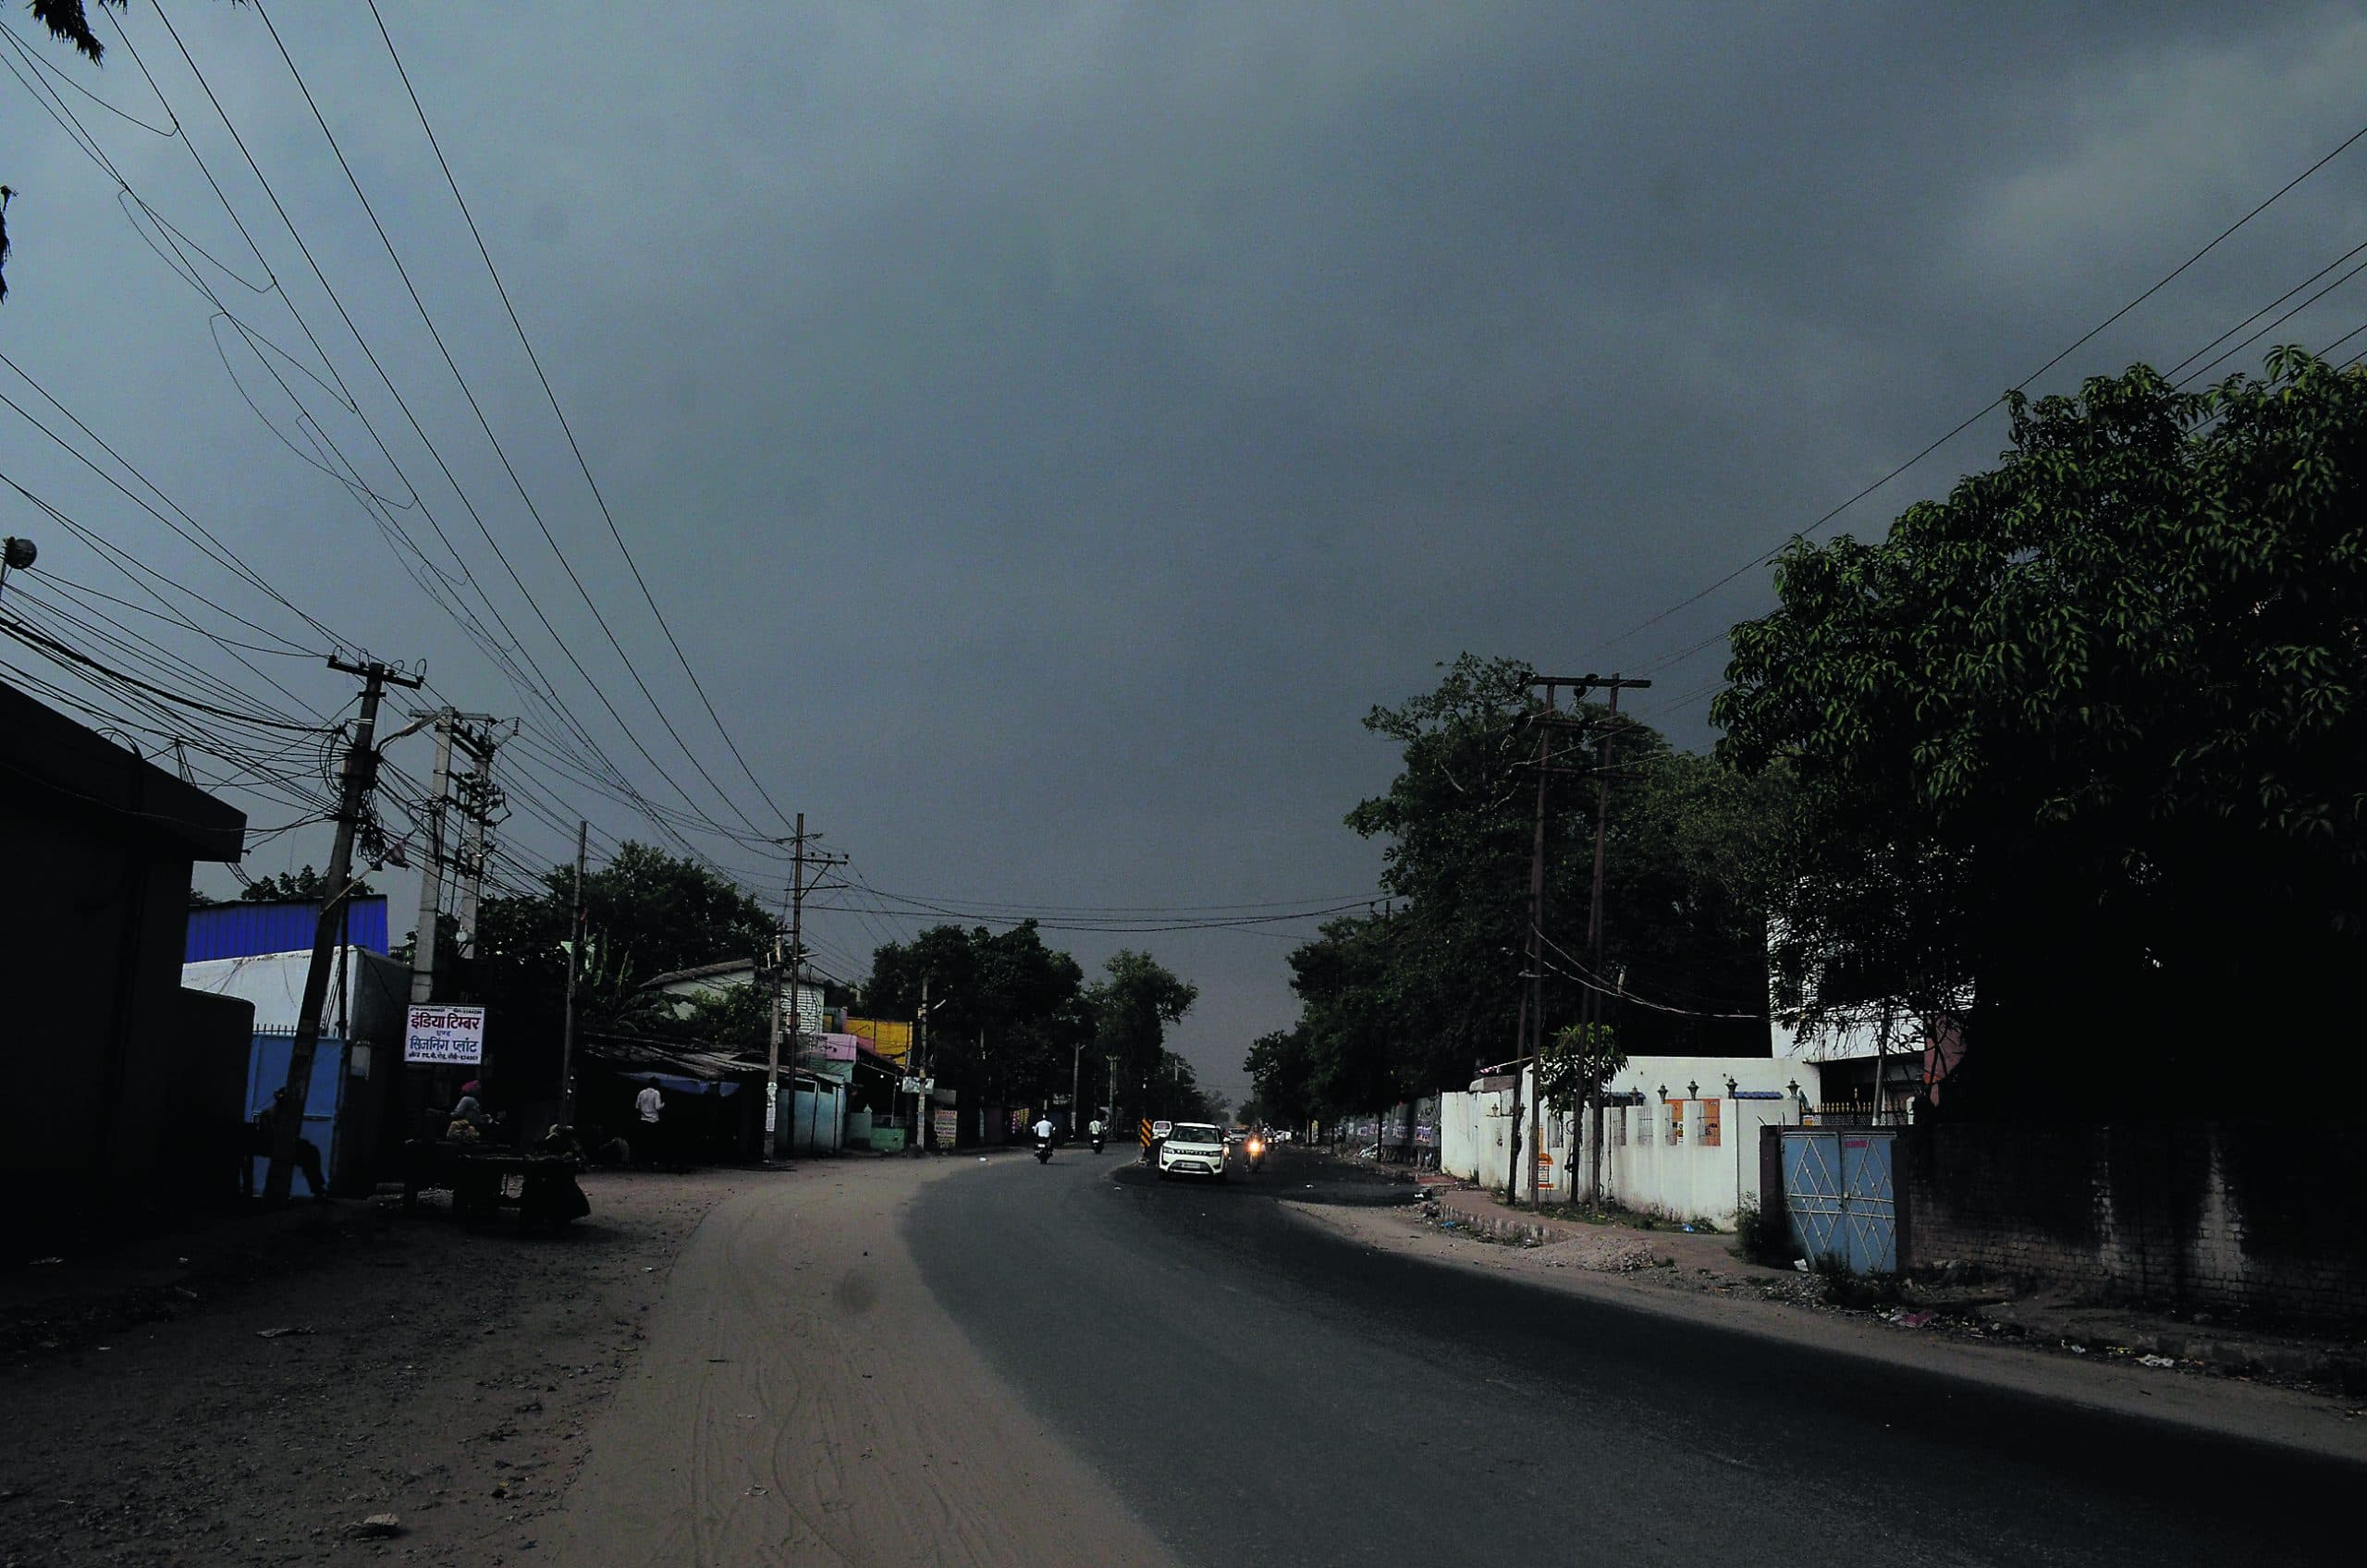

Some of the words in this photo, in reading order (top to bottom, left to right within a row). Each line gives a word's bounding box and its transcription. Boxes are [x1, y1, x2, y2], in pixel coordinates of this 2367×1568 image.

[411, 1012, 445, 1029] इंडिया
[447, 1012, 481, 1029] टिम्बर
[452, 1037, 478, 1052] प्लांट
